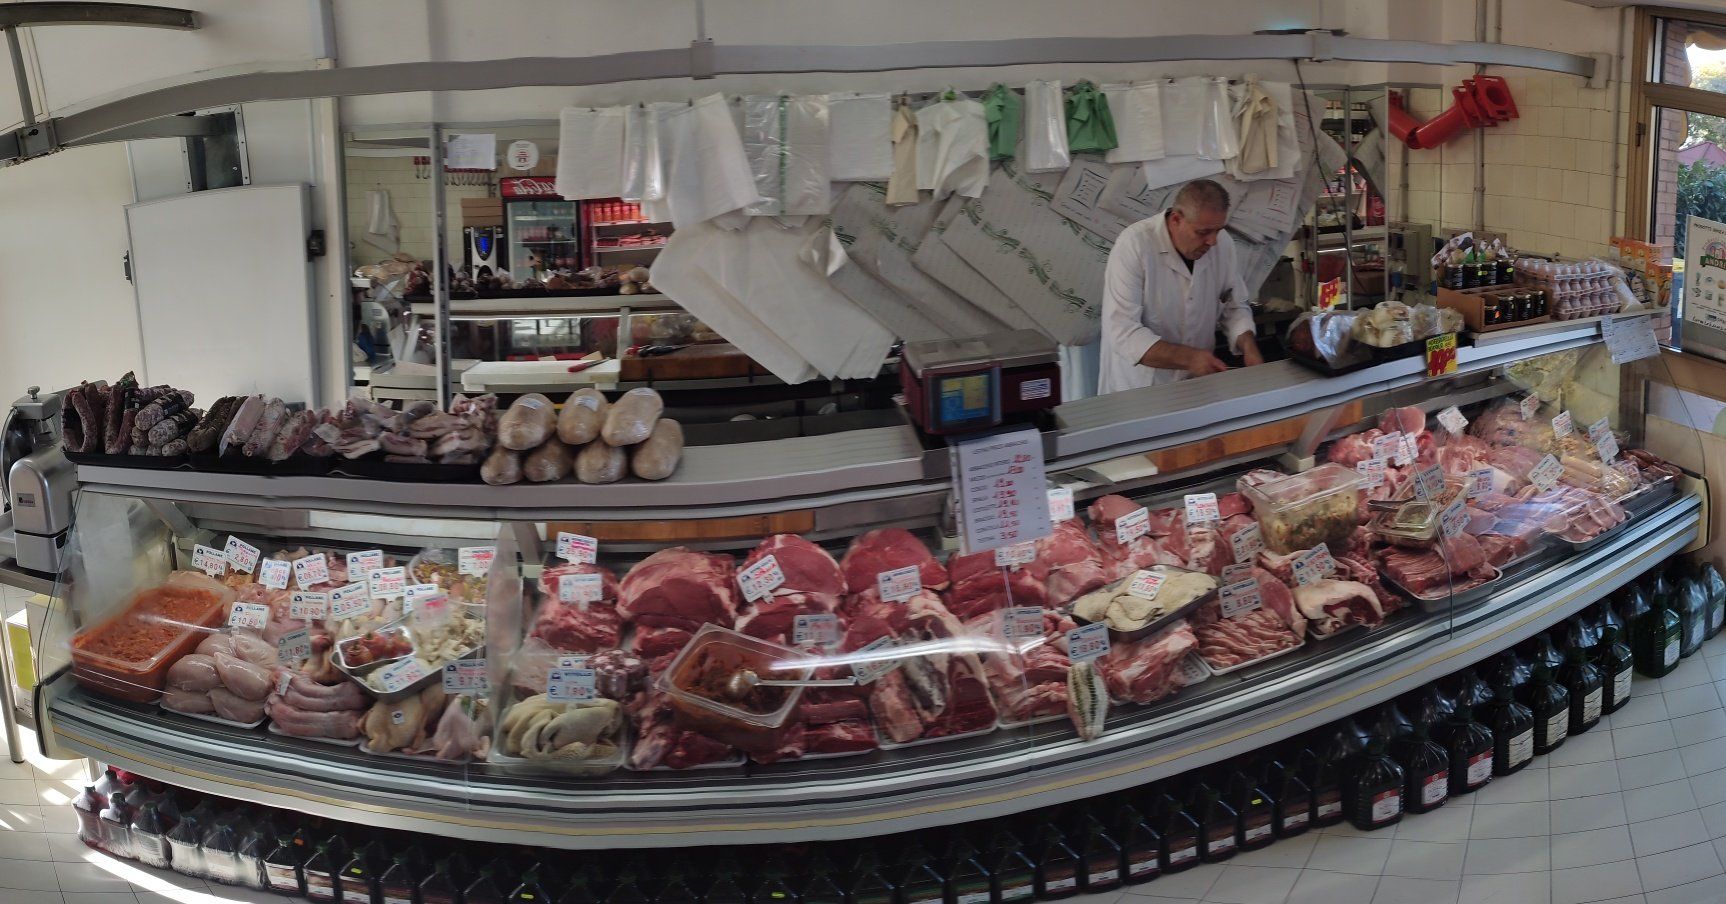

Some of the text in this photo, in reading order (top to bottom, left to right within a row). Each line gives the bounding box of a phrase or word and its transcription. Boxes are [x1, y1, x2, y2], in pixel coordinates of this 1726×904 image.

[239, 543, 257, 554] POLLAME
[205, 550, 223, 558] POLLAME
[343, 585, 363, 594] POLLAME
